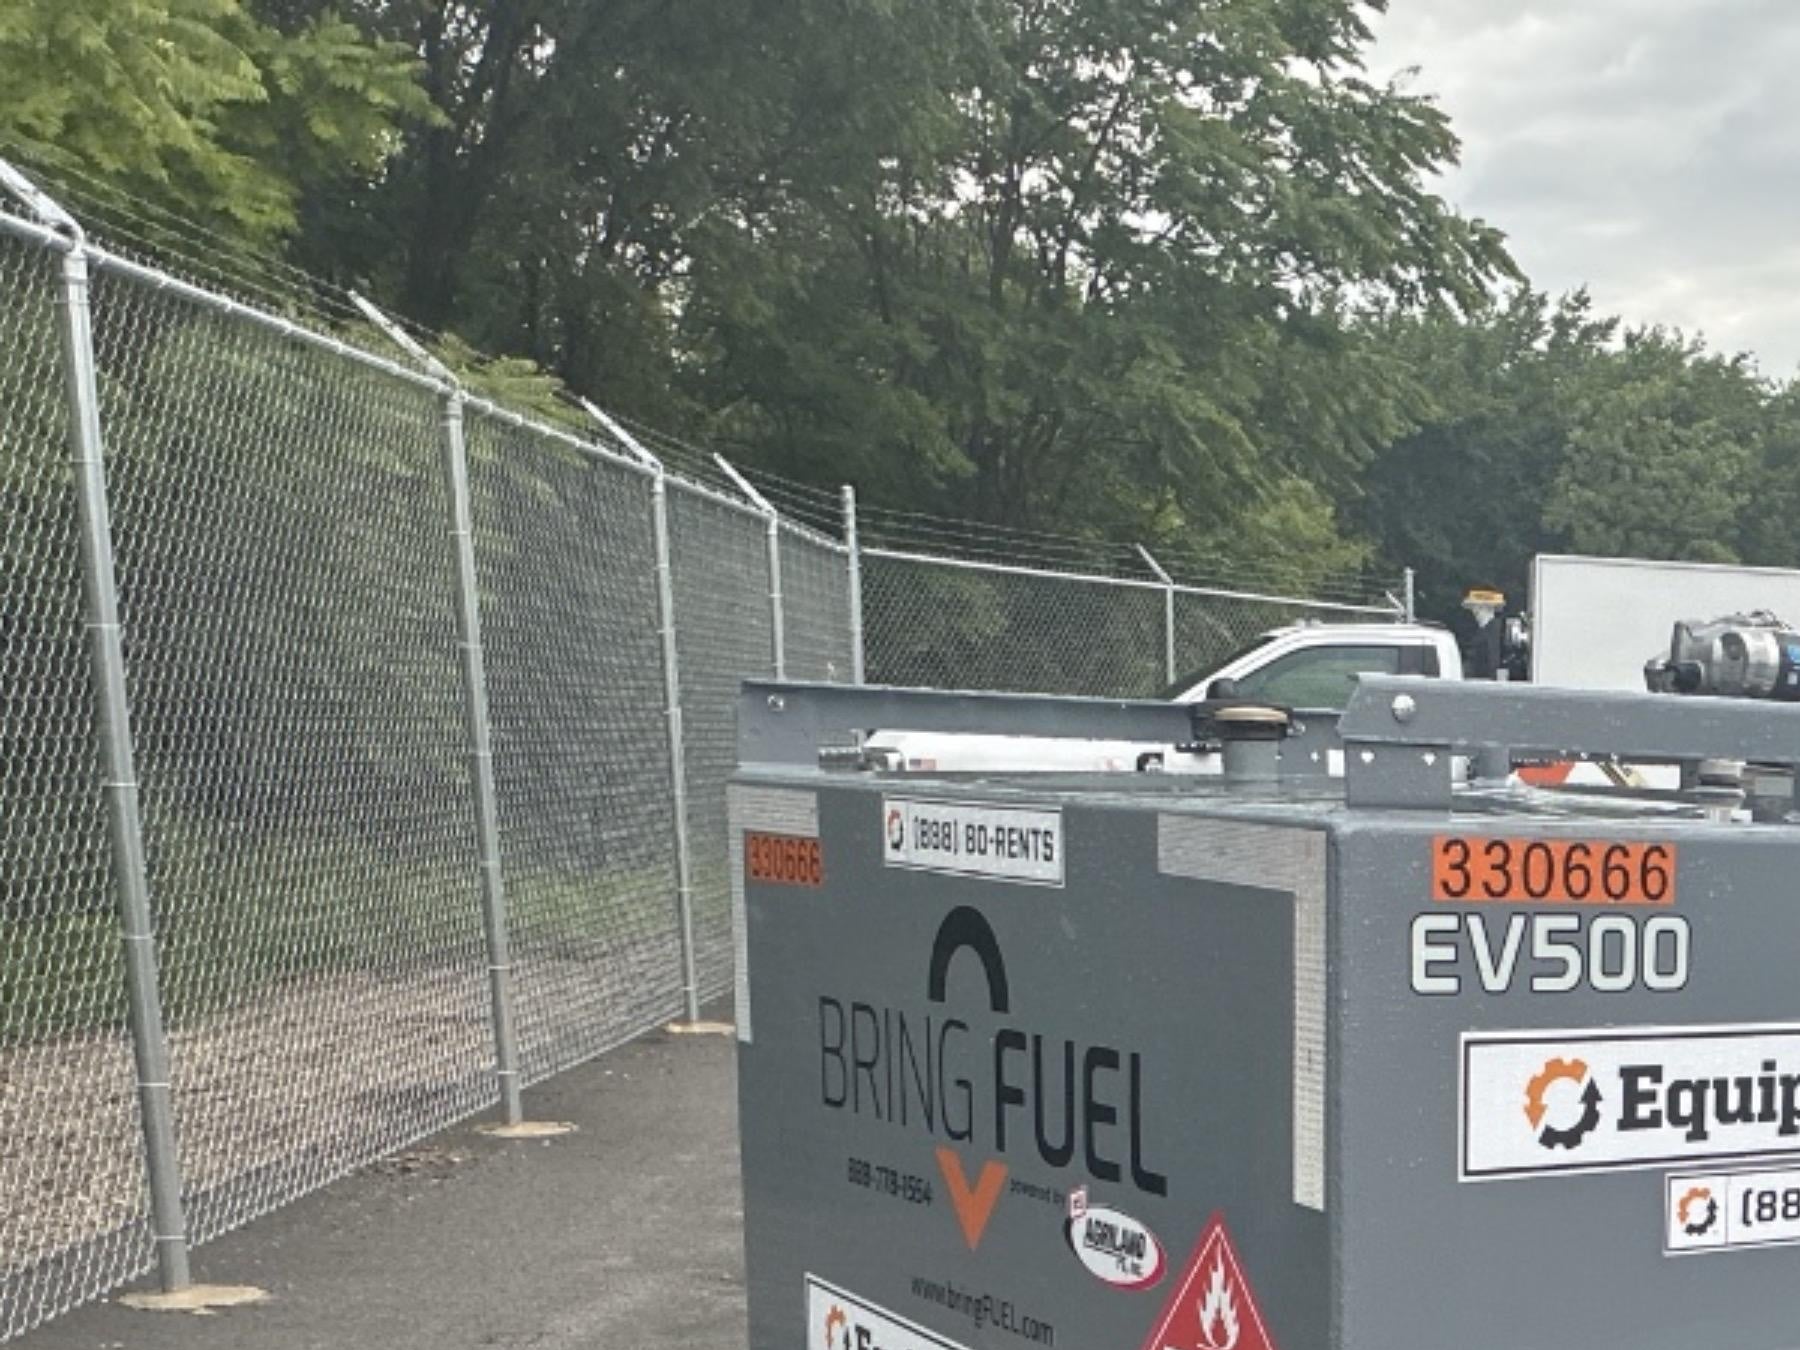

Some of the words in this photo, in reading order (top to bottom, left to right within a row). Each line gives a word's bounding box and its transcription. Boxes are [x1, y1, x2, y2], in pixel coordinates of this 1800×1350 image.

[750, 834, 821, 884] 330666
[913, 814, 958, 856] (888)
[964, 823, 1055, 862] 80-RENTS
[1439, 838, 1670, 901] 330666
[1408, 911, 1692, 996] EV500
[818, 995, 973, 1145] BRING
[994, 1028, 1168, 1198] FUEL
